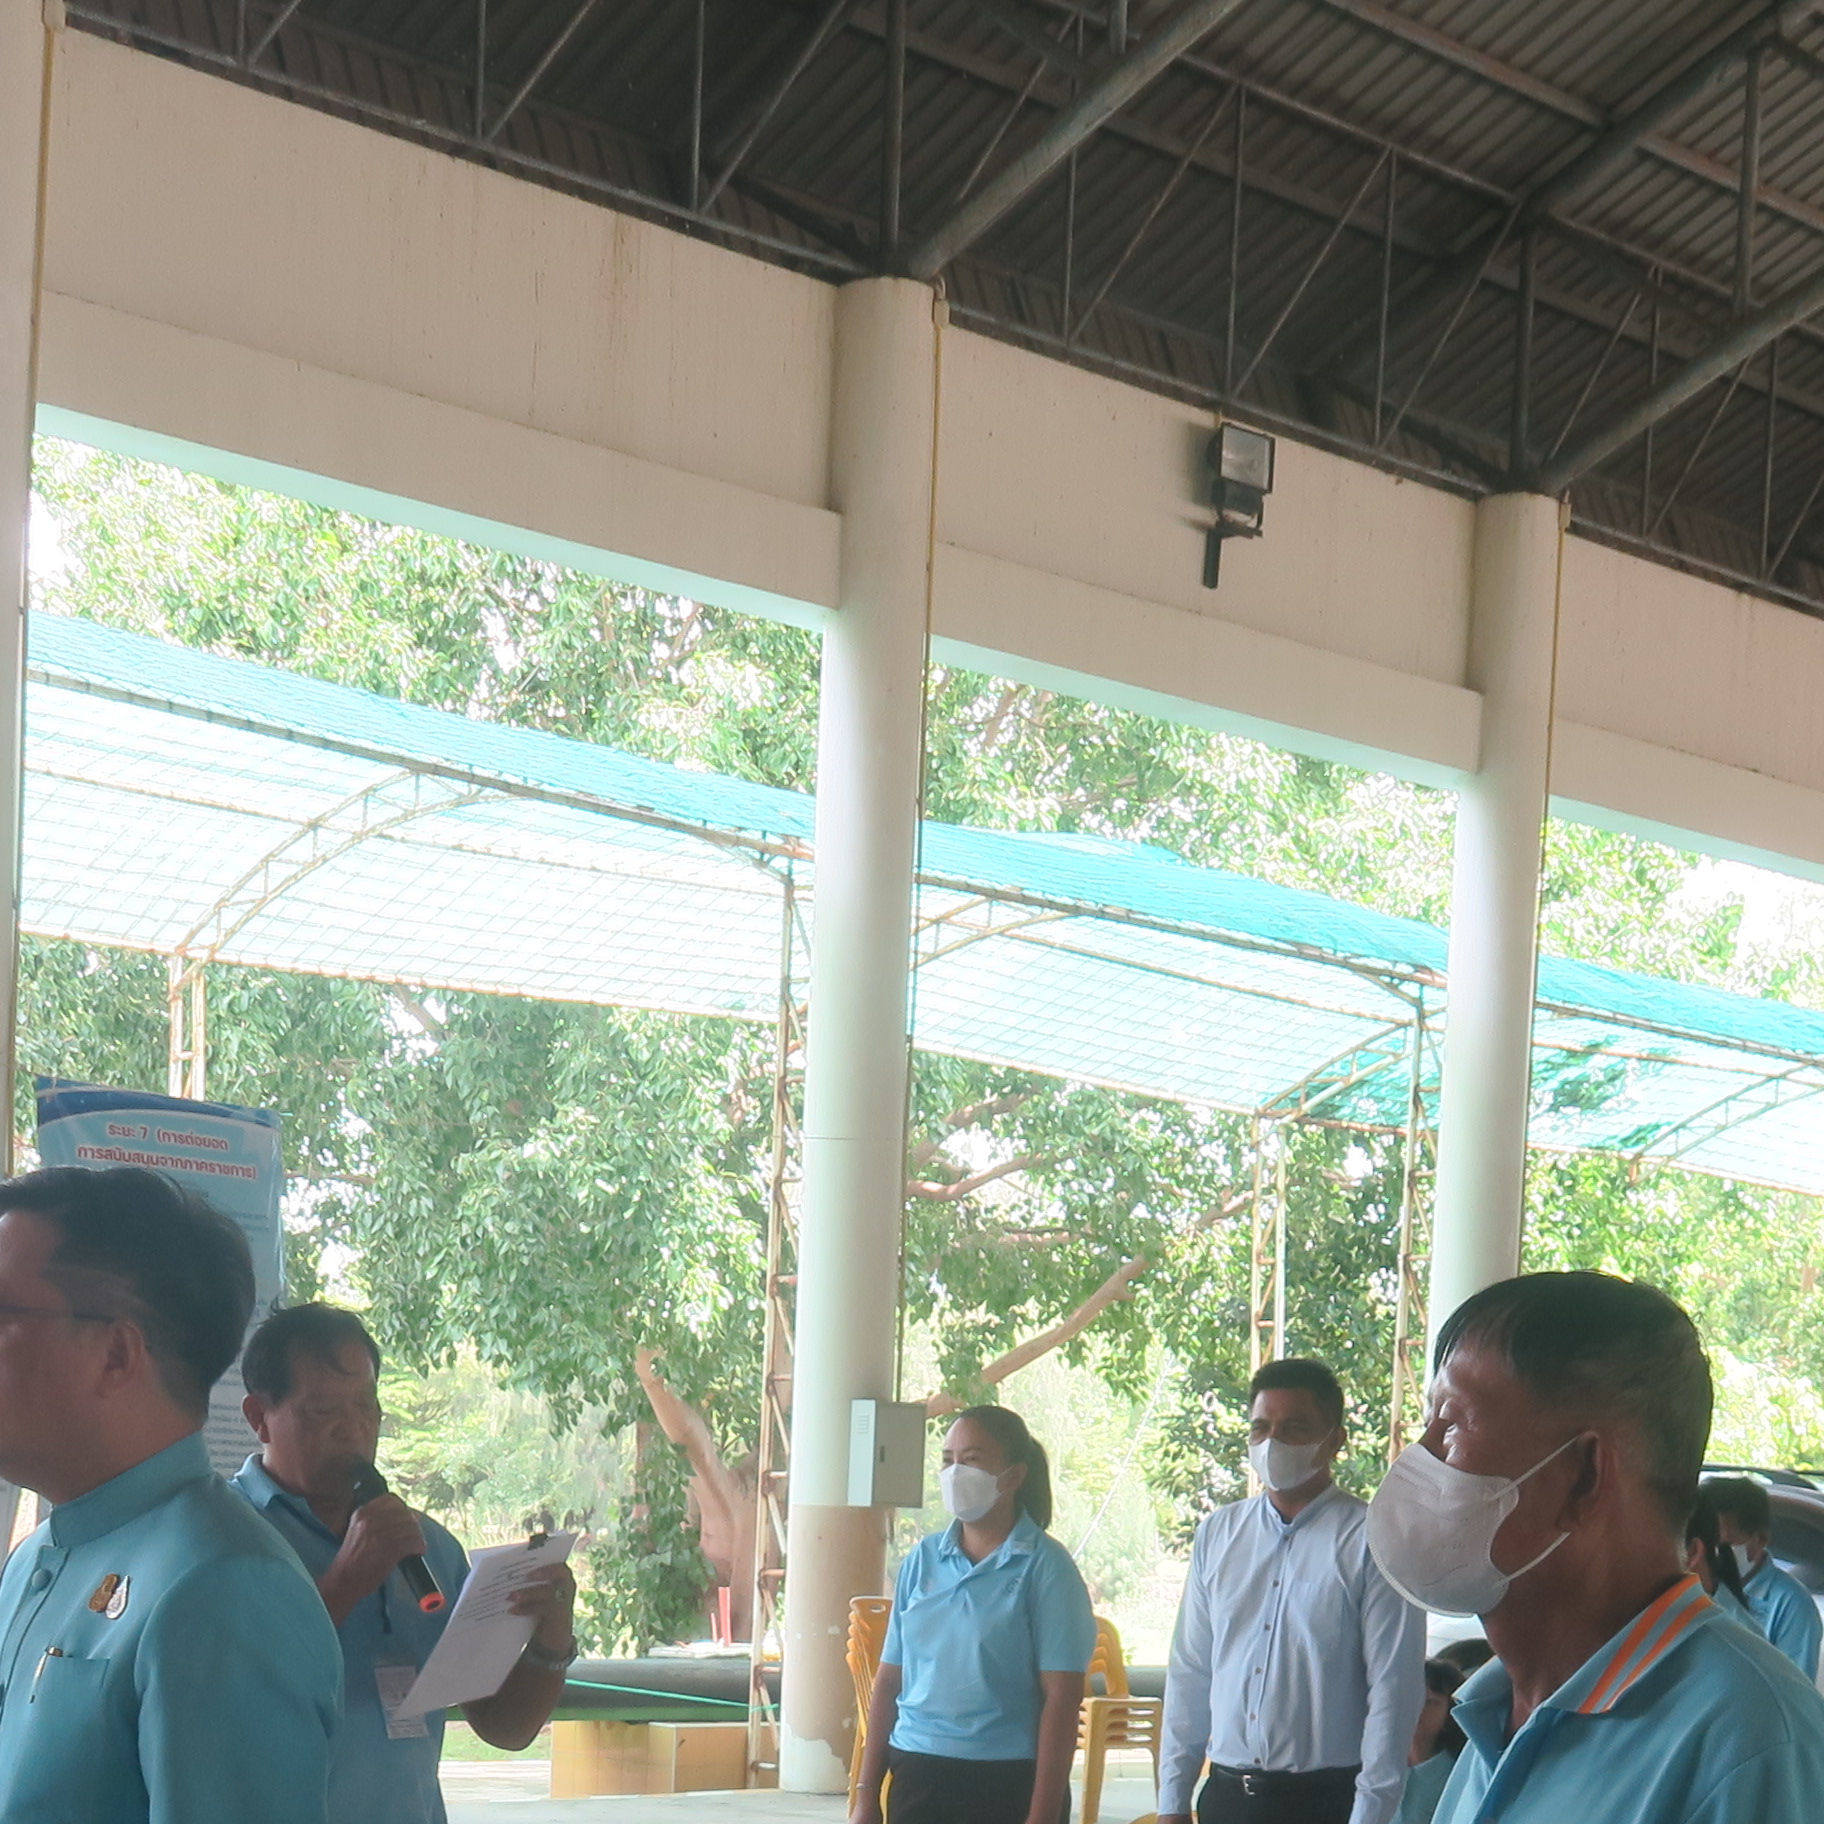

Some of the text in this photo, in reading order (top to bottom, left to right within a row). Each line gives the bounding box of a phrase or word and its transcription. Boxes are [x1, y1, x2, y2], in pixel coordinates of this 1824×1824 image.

[107, 1123, 229, 1151] ระยะ 7 (การต่อยอด
